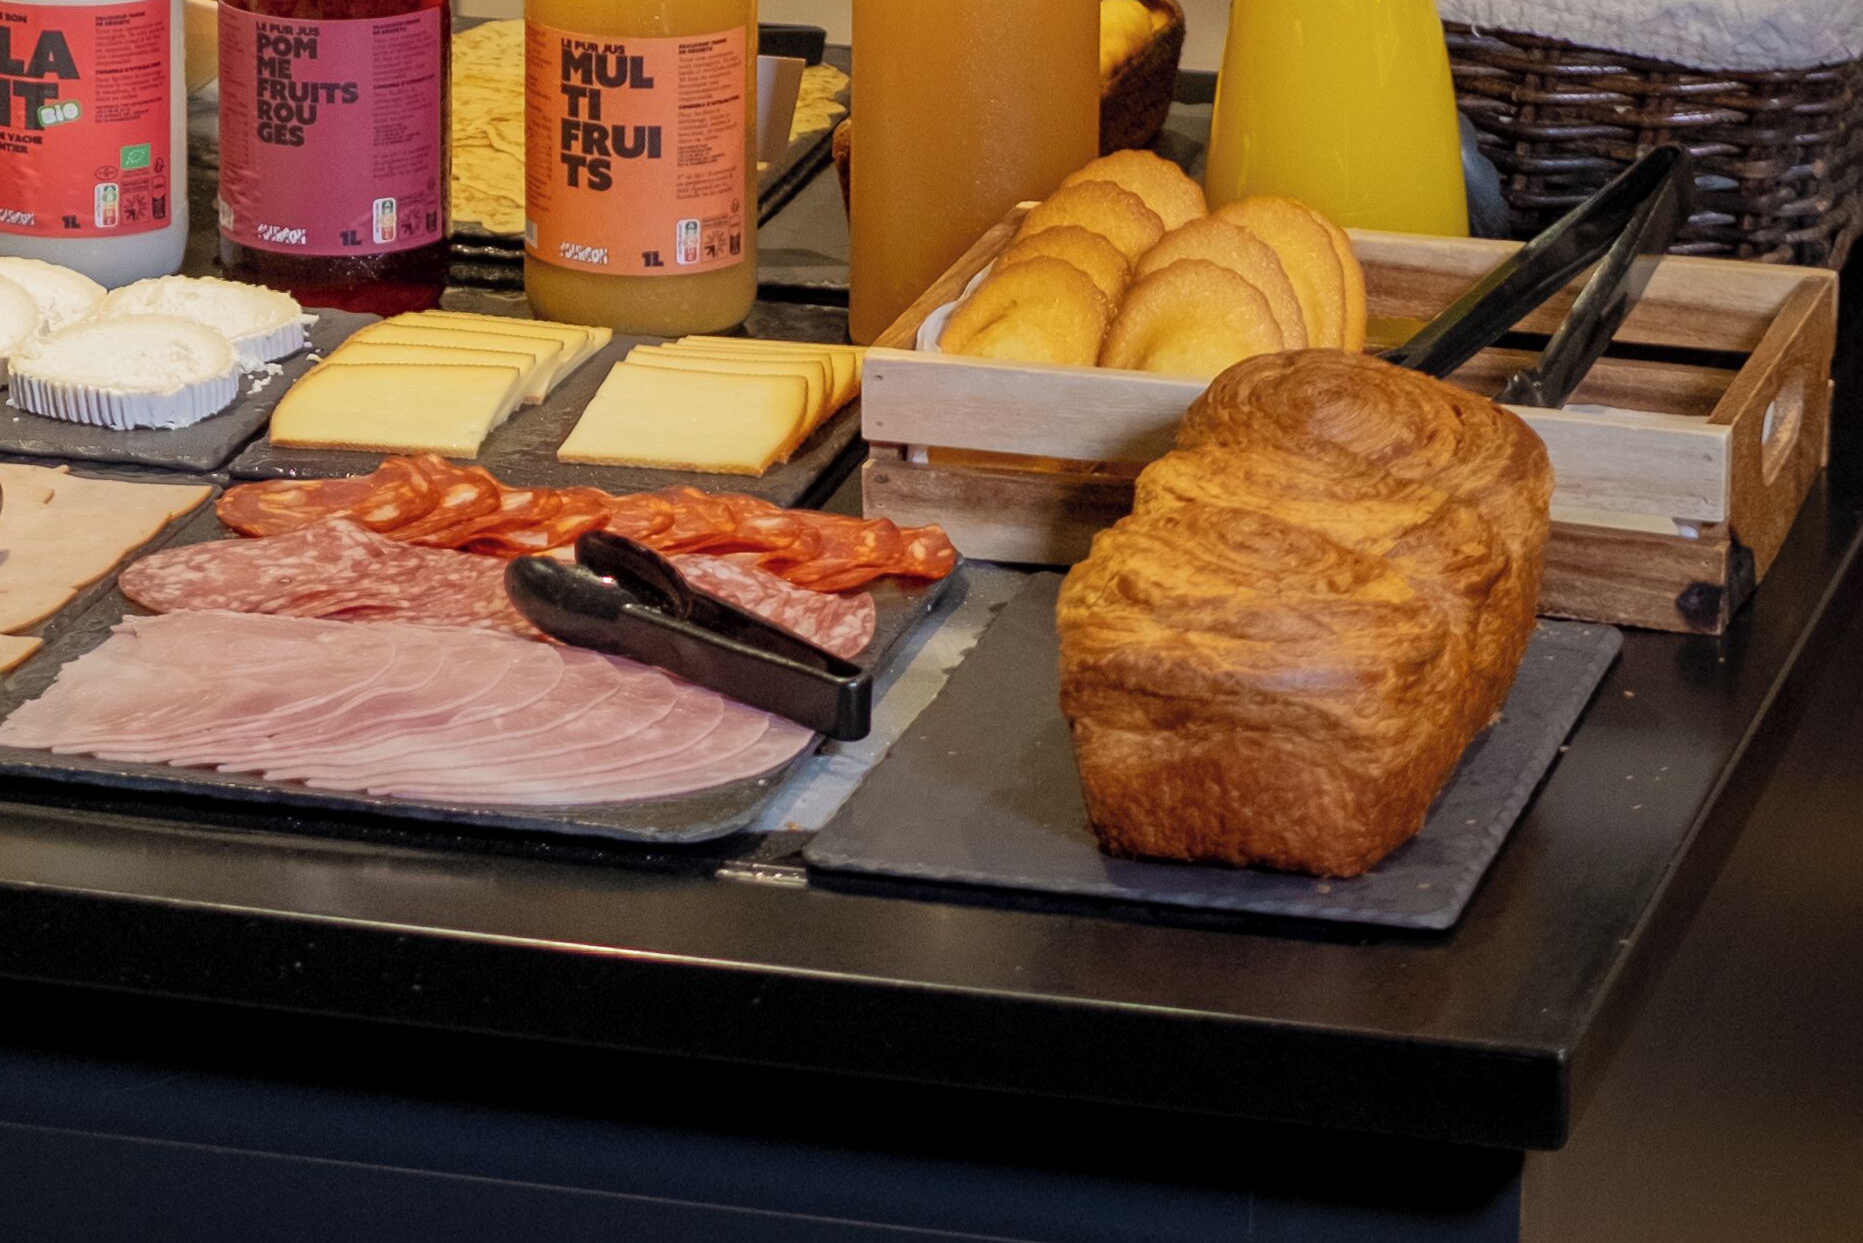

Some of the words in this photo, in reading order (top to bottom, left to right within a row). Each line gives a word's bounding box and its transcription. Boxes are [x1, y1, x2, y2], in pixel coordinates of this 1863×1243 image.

[256, 21, 268, 32] LE
[269, 24, 293, 35] PUR
[296, 26, 320, 37] JUS
[256, 33, 318, 59] POM
[561, 38, 573, 49] LE
[574, 41, 599, 52] PUR
[602, 43, 625, 55] JUS
[256, 56, 292, 80] ME
[561, 47, 654, 89] MUL
[256, 77, 359, 104] FRUITS
[560, 83, 601, 121] TI
[257, 100, 318, 126] ROU
[7, 132, 43, 145] VACHE
[257, 121, 305, 147] GES
[561, 117, 662, 159] FRUI
[560, 153, 613, 192] TS
[339, 230, 362, 246] 1L
[641, 250, 664, 267] 1L
